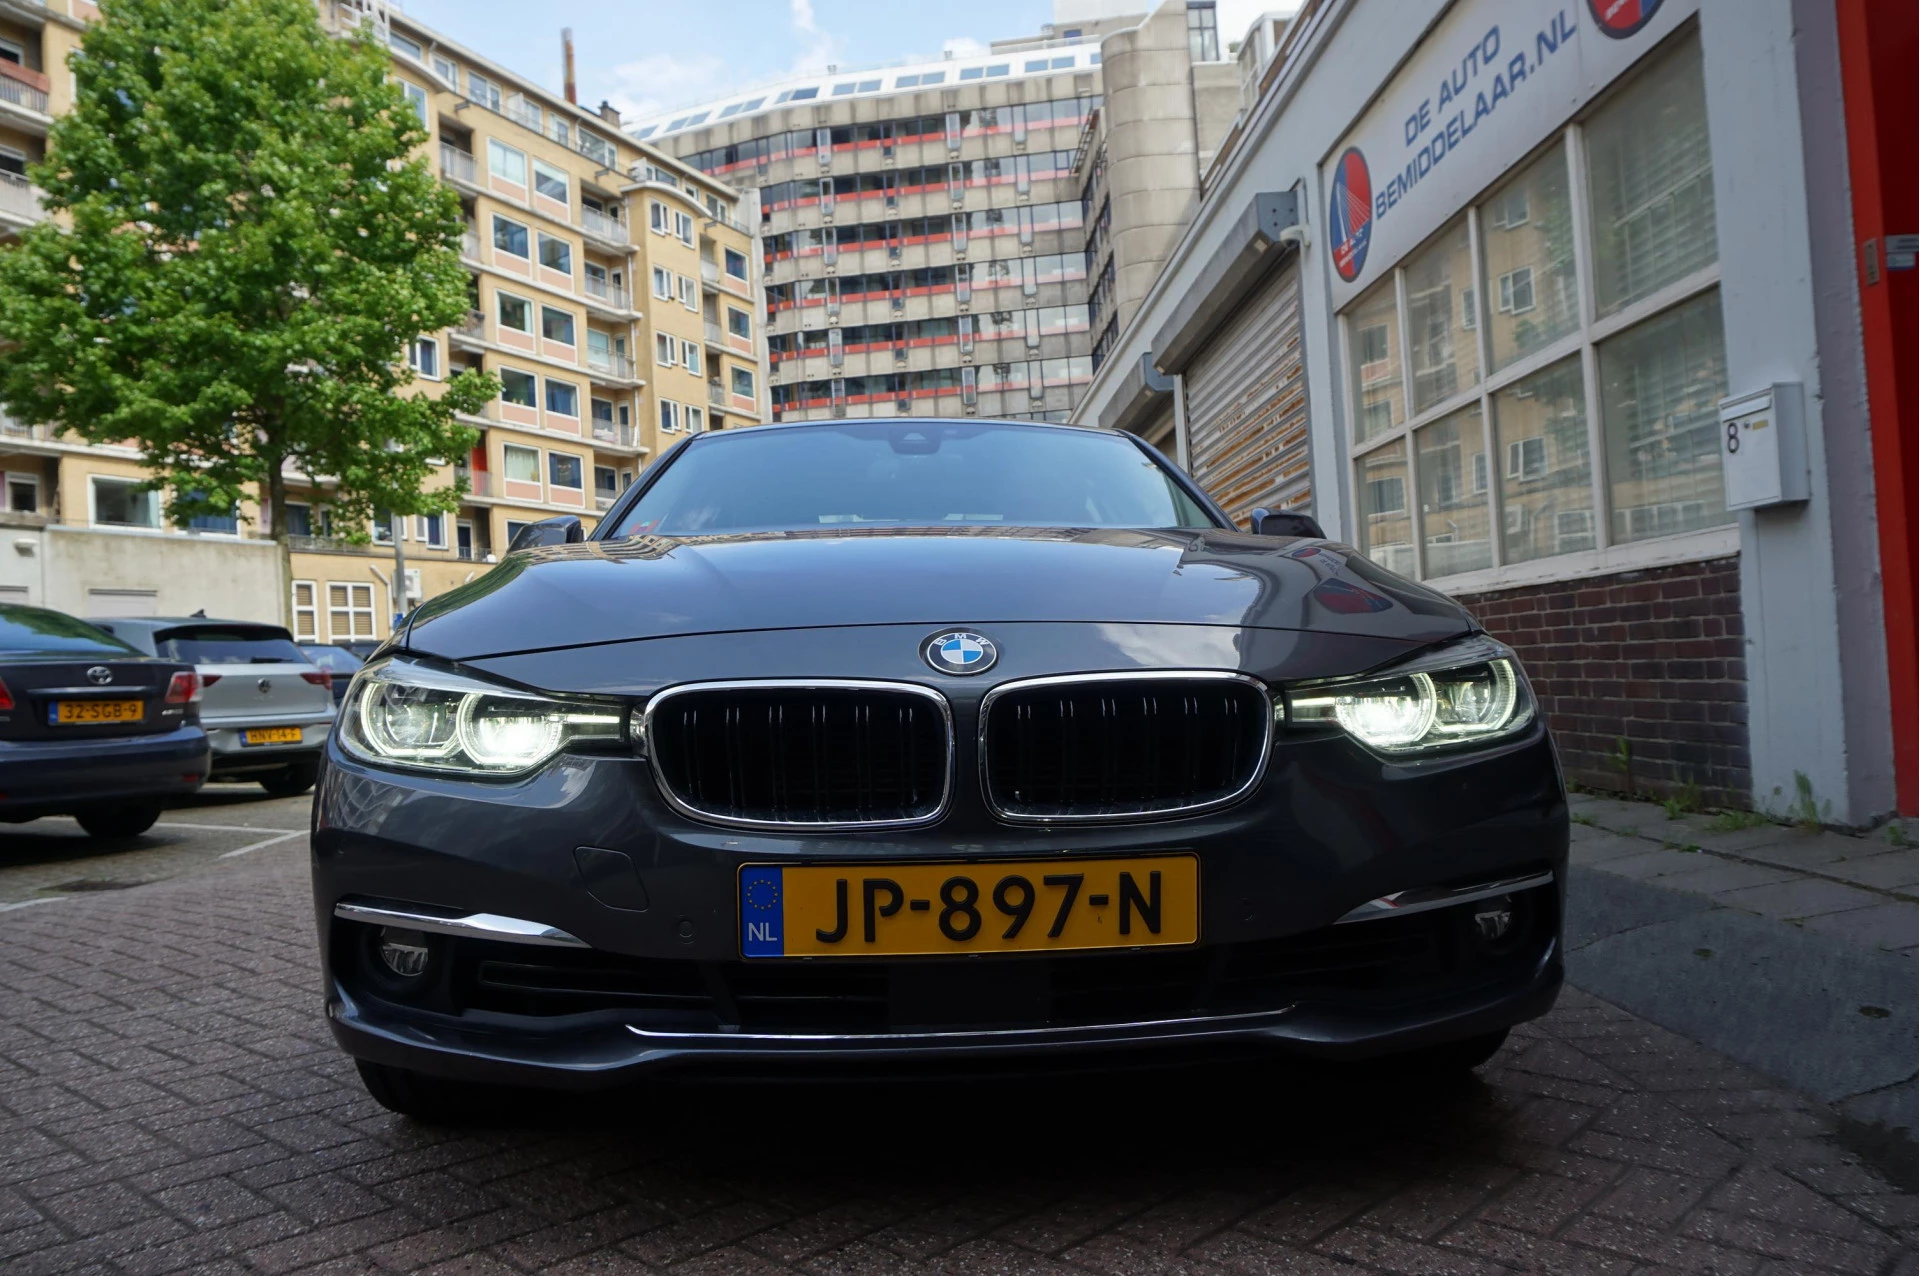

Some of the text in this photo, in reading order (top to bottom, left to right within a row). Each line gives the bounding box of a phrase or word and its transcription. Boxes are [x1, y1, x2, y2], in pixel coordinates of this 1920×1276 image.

[1404, 24, 1500, 147] DE AUTO
[1375, 9, 1577, 220] BEMIDDELAAR.NL
[1727, 422, 1740, 454] 8
[933, 632, 991, 646] BMW
[64, 703, 138, 719] 32-SGB-9
[748, 870, 1162, 943] NL JP-897-N
